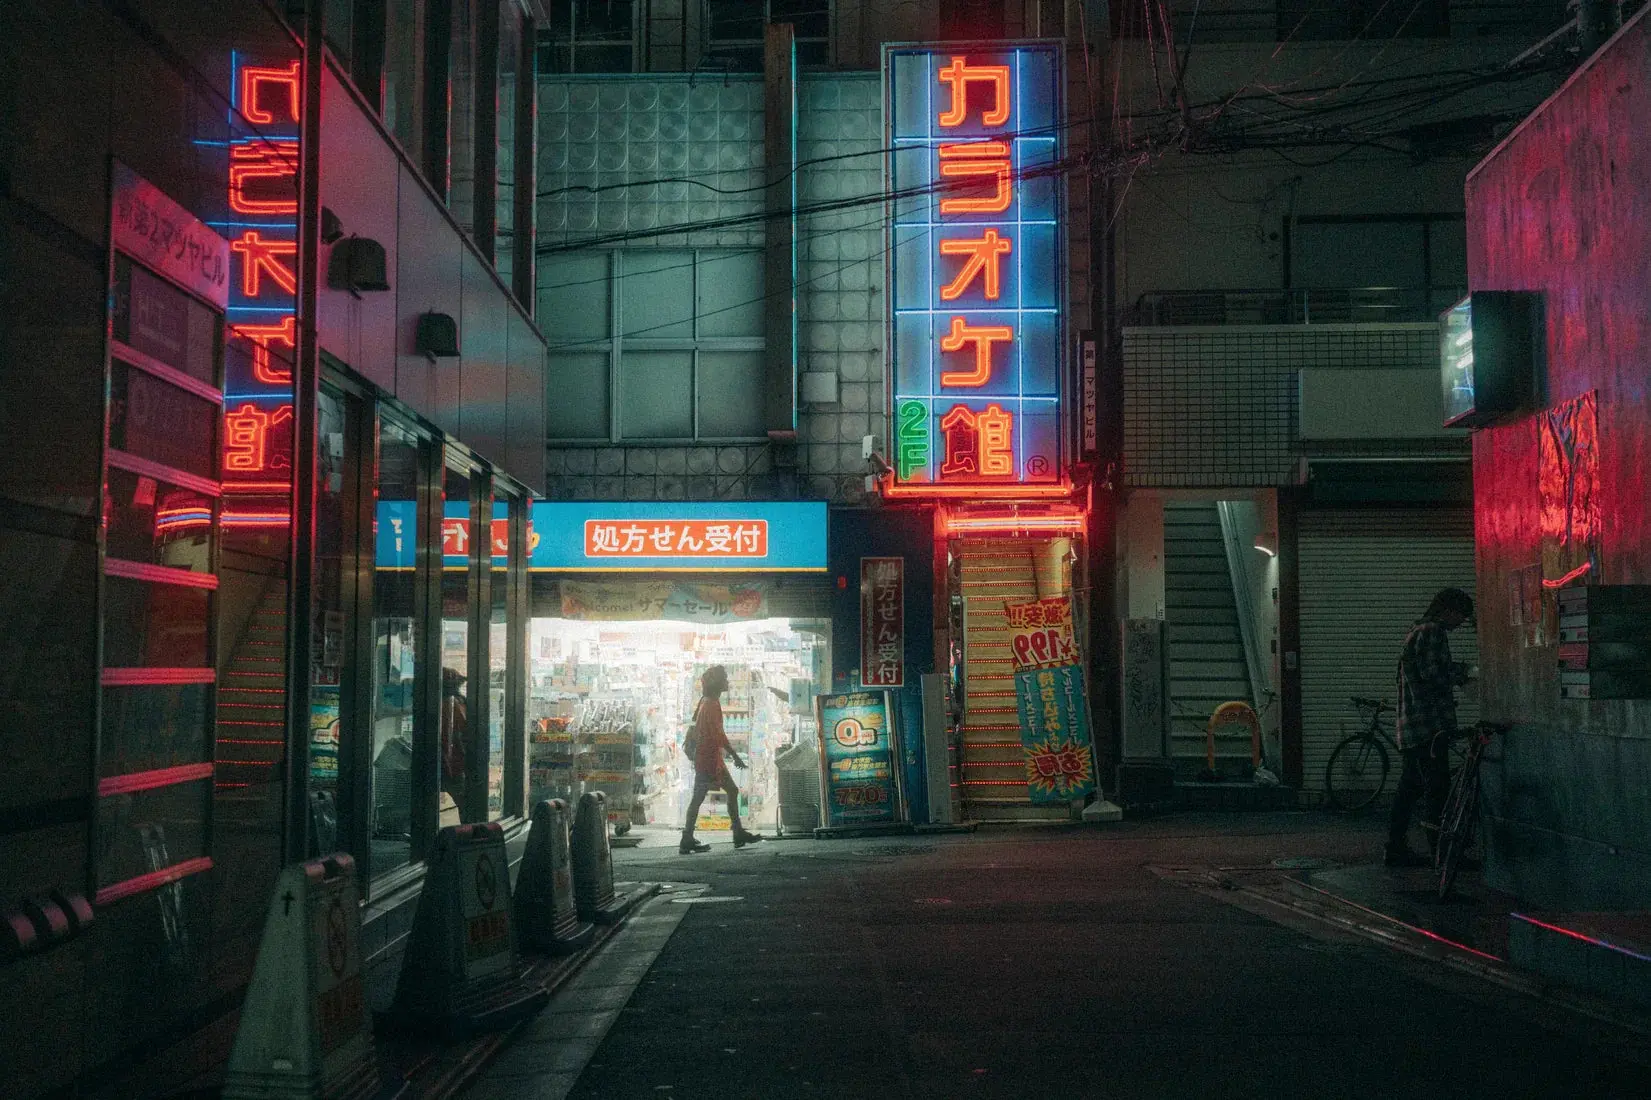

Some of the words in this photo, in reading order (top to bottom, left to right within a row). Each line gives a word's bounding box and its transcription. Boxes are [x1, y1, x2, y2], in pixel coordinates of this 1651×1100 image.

[939, 56, 1013, 477] カラオケ館
[899, 400, 929, 480] 2F
[1085, 349, 1096, 440] 第一マツヤビル
[592, 524, 761, 553] 処方せん受付
[876, 560, 899, 684] 処方せん受付
